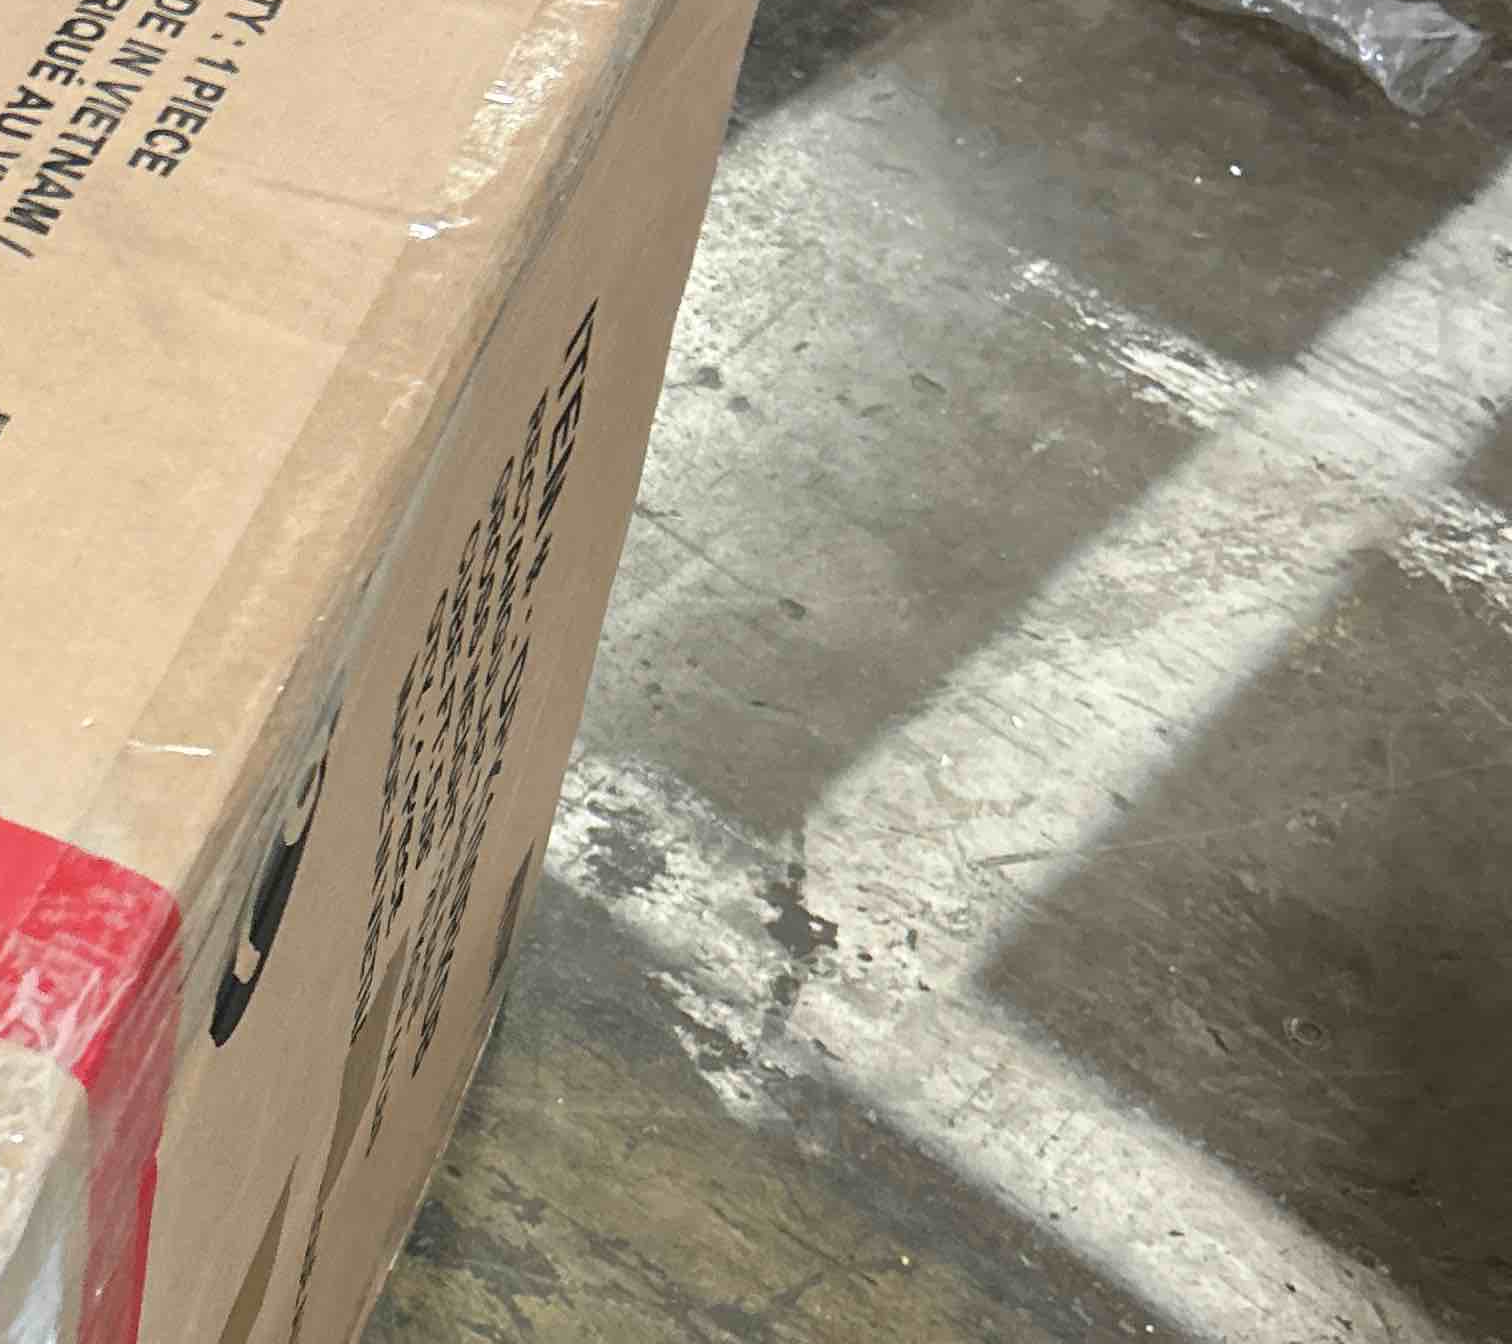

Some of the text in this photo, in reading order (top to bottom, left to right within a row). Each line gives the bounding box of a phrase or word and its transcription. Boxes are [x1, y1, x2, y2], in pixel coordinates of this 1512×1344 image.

[107, 37, 169, 77] IN
[124, 74, 228, 179] PIECE
[193, 51, 244, 75] 1
[0, 75, 142, 236] VIETNAM
[532, 292, 600, 549] ITEM
[440, 519, 482, 691] CUBE
[465, 387, 549, 787] RECTANGULAR
[411, 630, 531, 1080] DPK100RKDB
